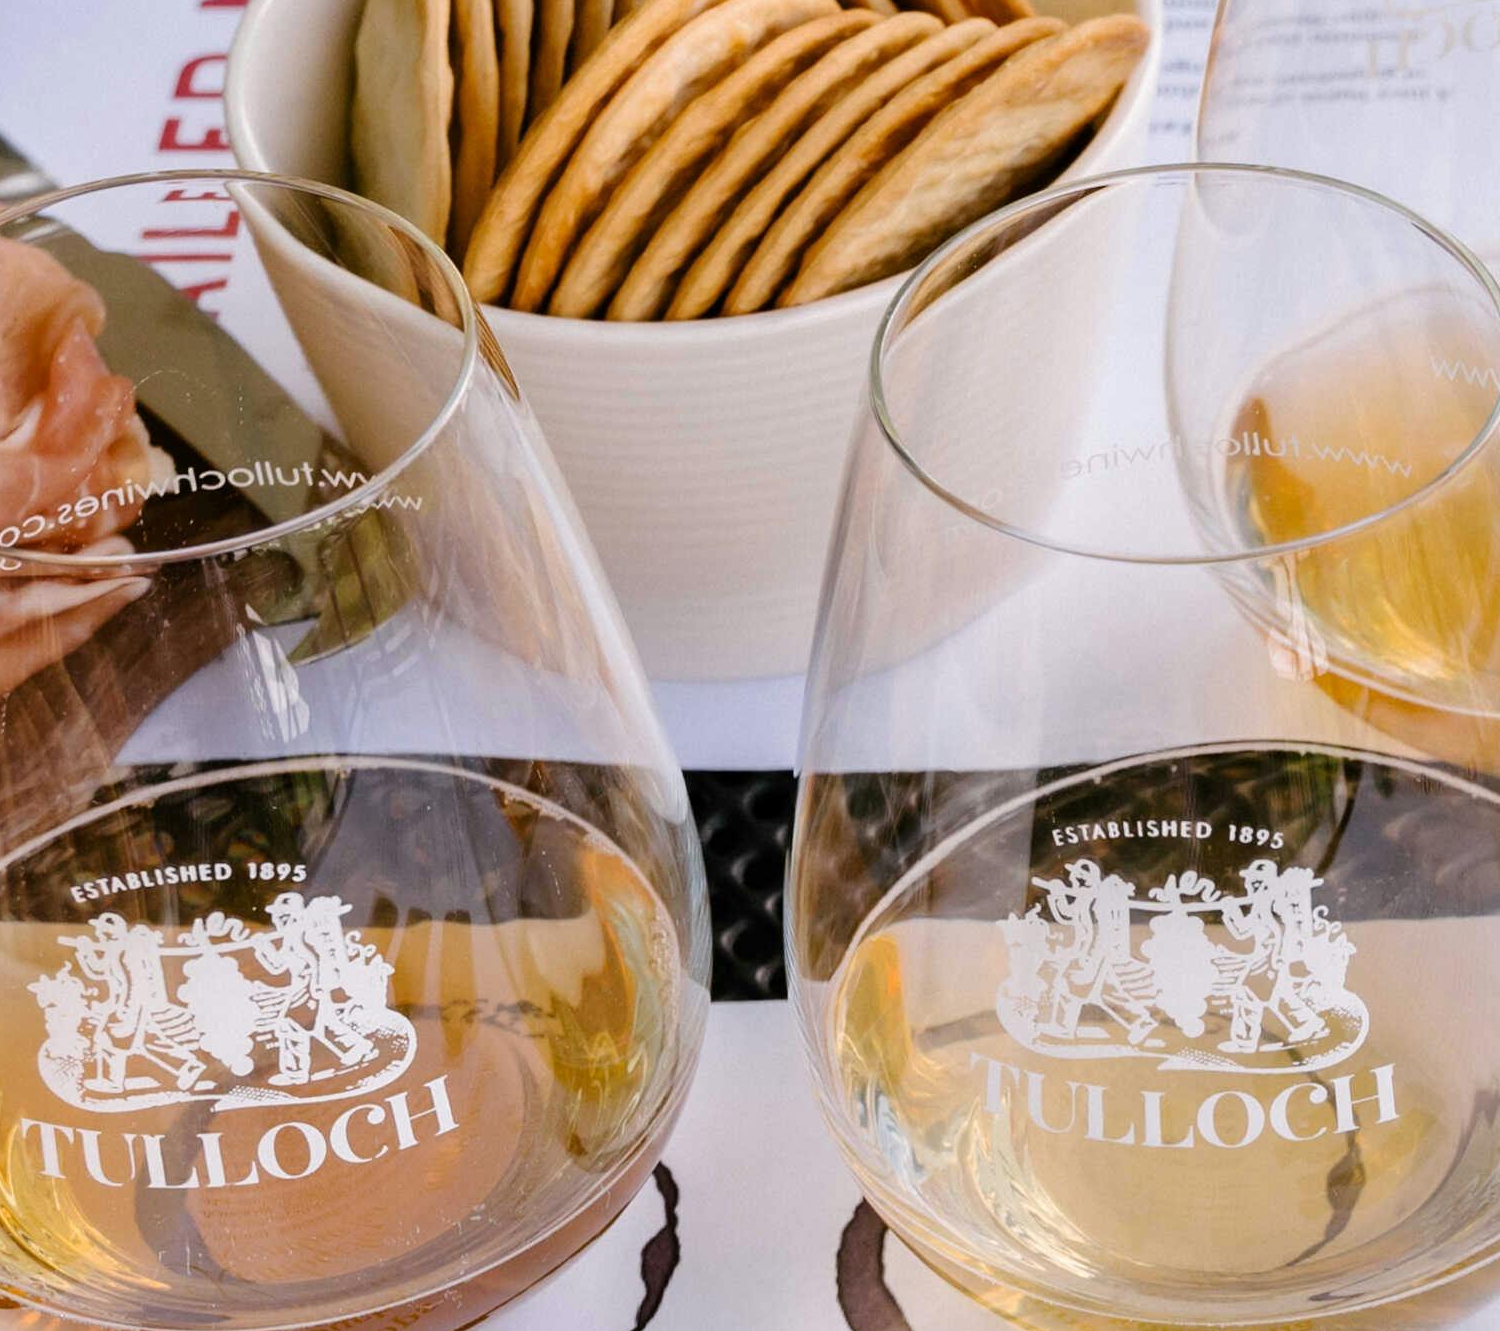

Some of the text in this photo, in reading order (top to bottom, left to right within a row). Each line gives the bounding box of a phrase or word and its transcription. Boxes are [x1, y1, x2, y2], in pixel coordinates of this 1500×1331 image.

[1051, 819, 1286, 851] ESTABLISHED 1895
[70, 861, 309, 904] ESTABLISHED 1895
[19, 1073, 461, 1191] TULLOCH
[969, 1061, 1401, 1150] TULLOCH
